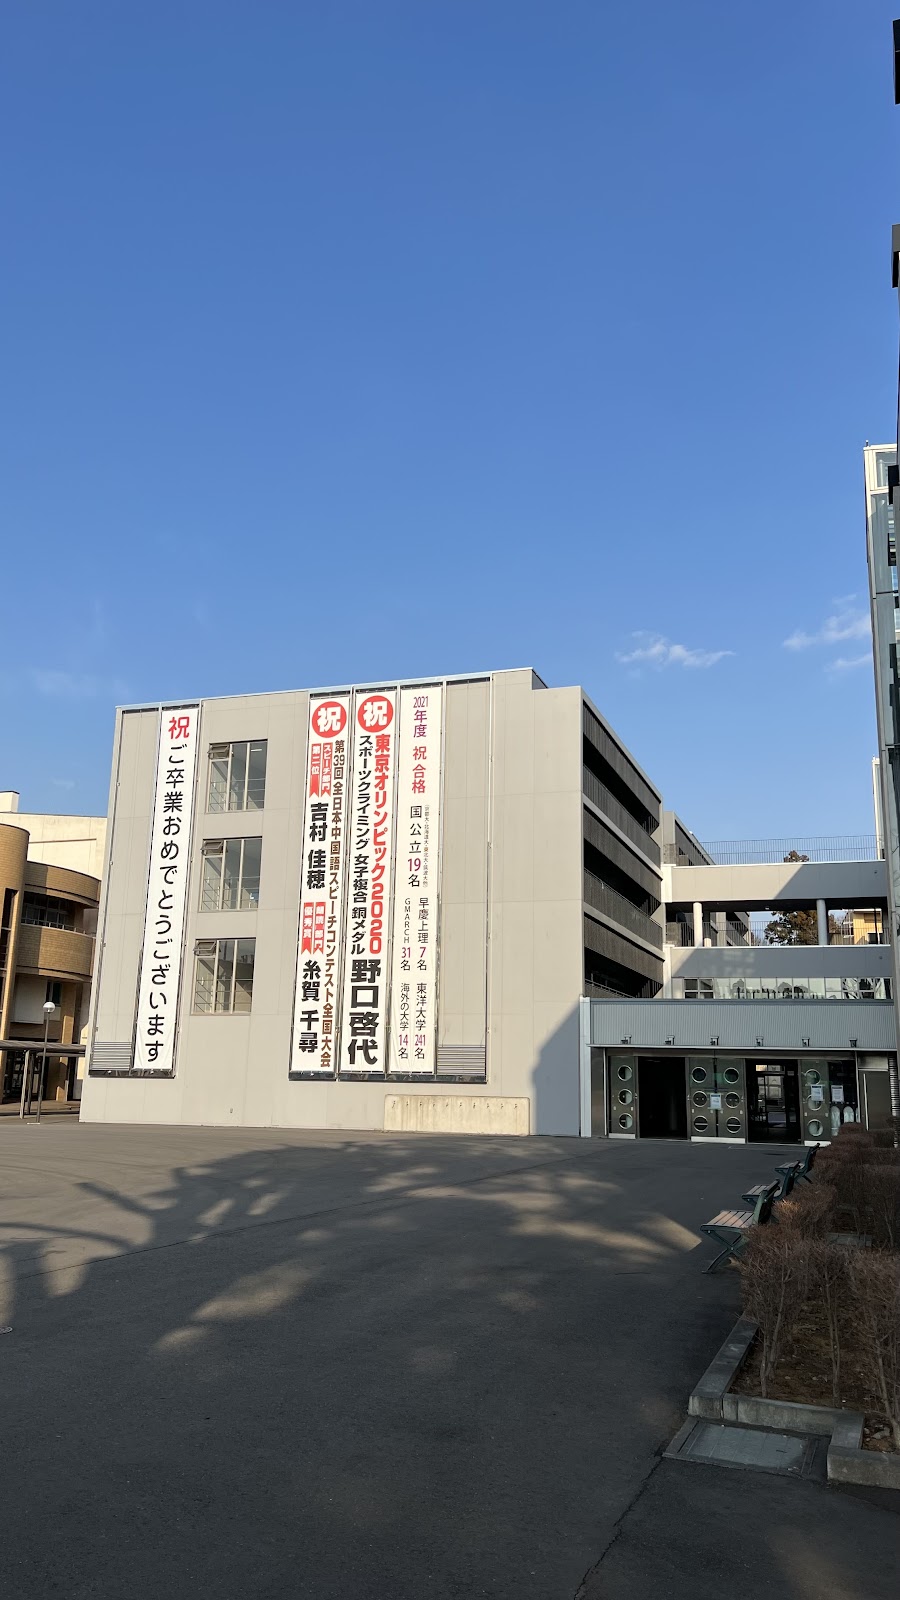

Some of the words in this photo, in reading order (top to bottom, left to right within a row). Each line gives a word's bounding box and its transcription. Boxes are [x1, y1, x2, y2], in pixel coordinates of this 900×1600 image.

[317, 706, 342, 732] 祝
[363, 700, 388, 727] 祝
[413, 696, 429, 738] 2021年度
[369, 733, 391, 955] 東京オリンピック2020
[347, 958, 382, 1065] 野口啓代
